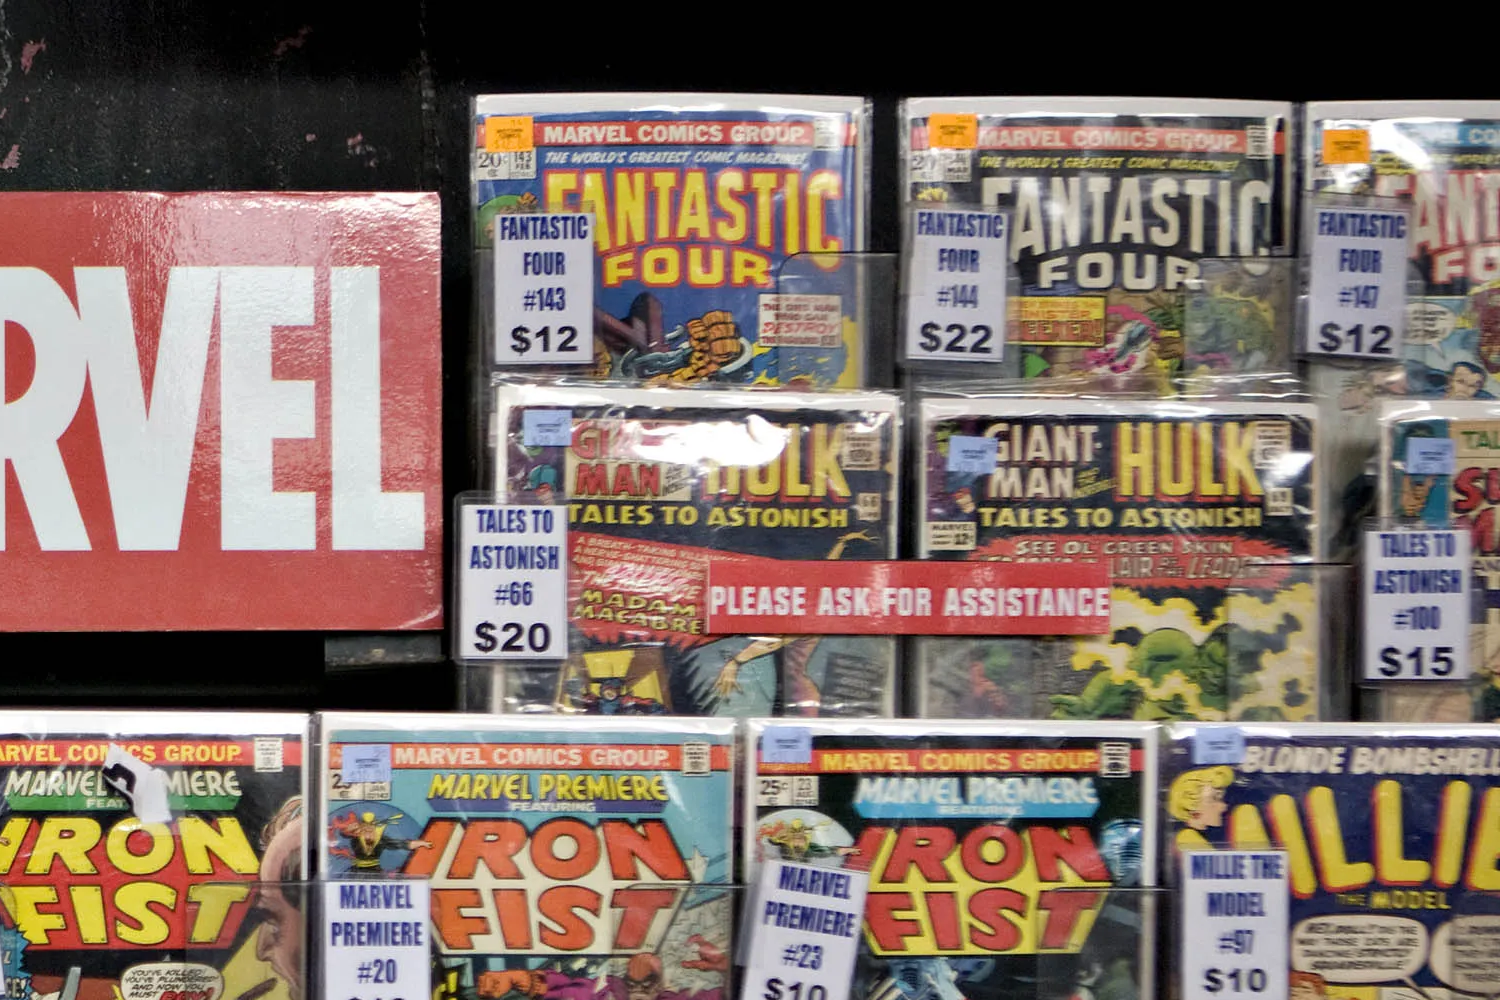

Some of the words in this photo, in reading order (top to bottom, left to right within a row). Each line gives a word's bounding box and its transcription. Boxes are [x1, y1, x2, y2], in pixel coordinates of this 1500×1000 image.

[500, 216, 588, 240] FANTASTIC
[543, 169, 842, 271] FANTASTIC
[917, 212, 1003, 238] FANTASTIC
[982, 177, 1271, 276] FANTASTIC
[523, 252, 565, 276] FOUR
[602, 245, 773, 289] FOUR
[938, 248, 980, 272] FOUR
[1037, 251, 1202, 291] FOUR
[523, 288, 565, 311] #143
[937, 286, 978, 309] #144
[510, 325, 579, 355] $12
[919, 322, 993, 354] $22
[1318, 322, 1393, 354] $12
[1116, 422, 1264, 502] HULK
[477, 509, 525, 533] TALES
[532, 509, 553, 533] TO
[568, 504, 653, 525] TALES
[661, 506, 698, 525] TO
[707, 506, 848, 528] ASTONISH
[979, 507, 1069, 527] TALES
[1079, 507, 1113, 527] TO
[1120, 507, 1262, 527] ASTONISH
[469, 546, 559, 570] ASTONISH
[495, 582, 533, 606] #66
[711, 587, 805, 616] PLEASE
[818, 587, 869, 616] ASK
[883, 587, 931, 617] FOR
[945, 587, 1110, 616] ASSISTANCE
[474, 622, 551, 654] $20
[1379, 646, 1453, 676] $15
[402, 816, 691, 881] IRON
[846, 826, 1110, 882] IRON
[340, 885, 413, 909] MARVEL
[1207, 893, 1265, 917] MODEL
[432, 885, 680, 950] FIST
[866, 888, 1101, 951] FIST
[332, 921, 422, 946] PREMIERE
[783, 944, 824, 970] #23
[357, 959, 396, 984] #20
[1203, 968, 1267, 994] $10
